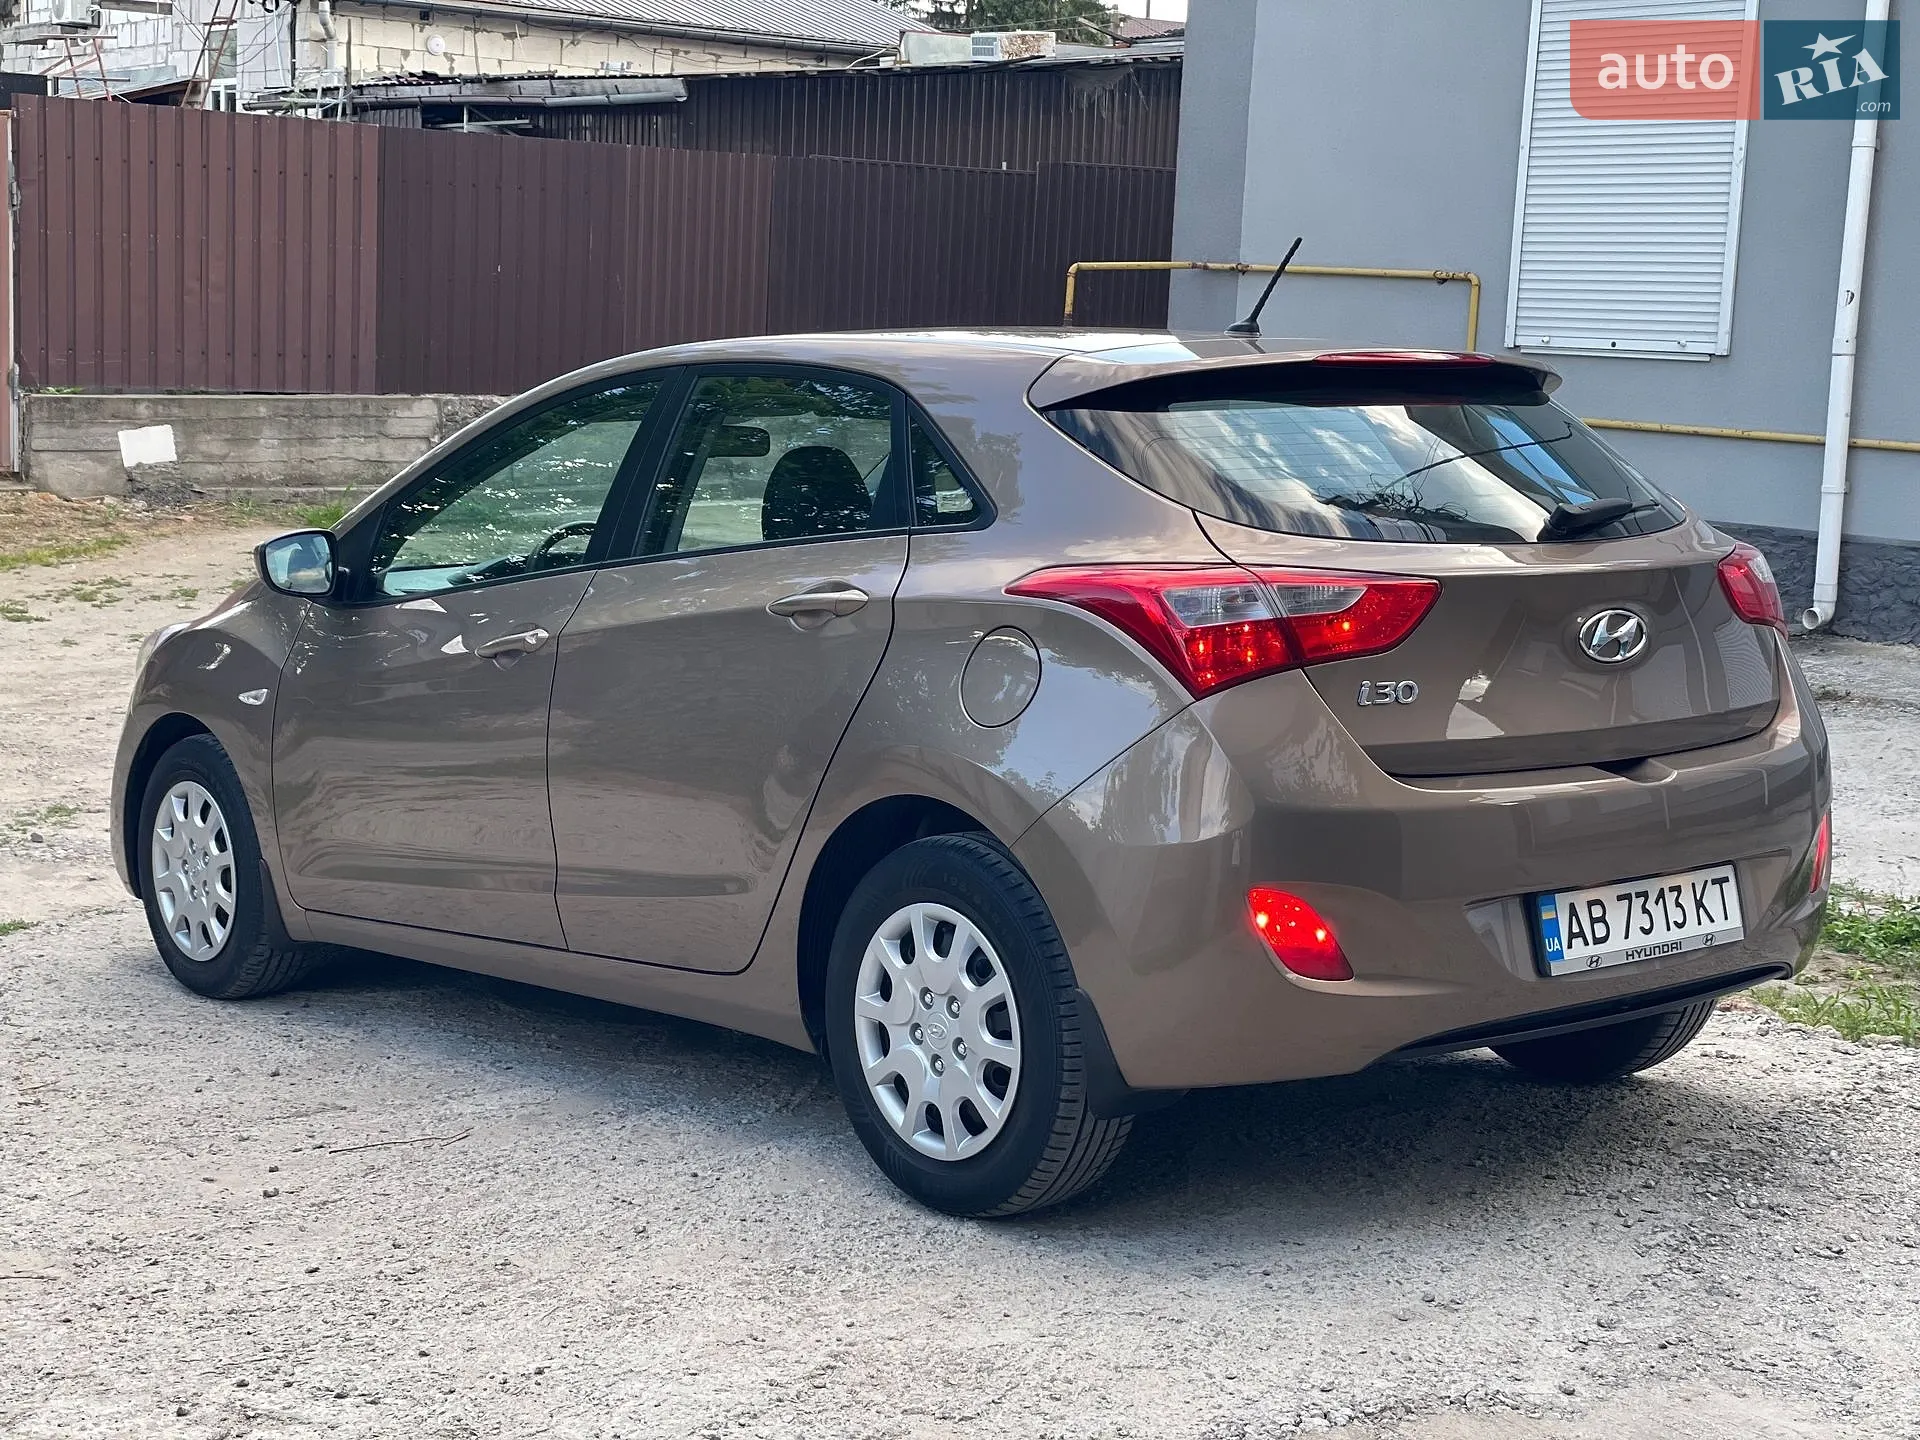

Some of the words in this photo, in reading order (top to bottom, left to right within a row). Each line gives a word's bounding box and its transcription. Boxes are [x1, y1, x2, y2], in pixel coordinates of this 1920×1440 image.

[1357, 680, 1419, 707] i30
[1567, 898, 1610, 949] AB
[1616, 884, 1687, 940] 7313
[1692, 876, 1730, 926] KT
[1545, 938, 1562, 952] UA
[1625, 941, 1683, 961] HYUNDAI
